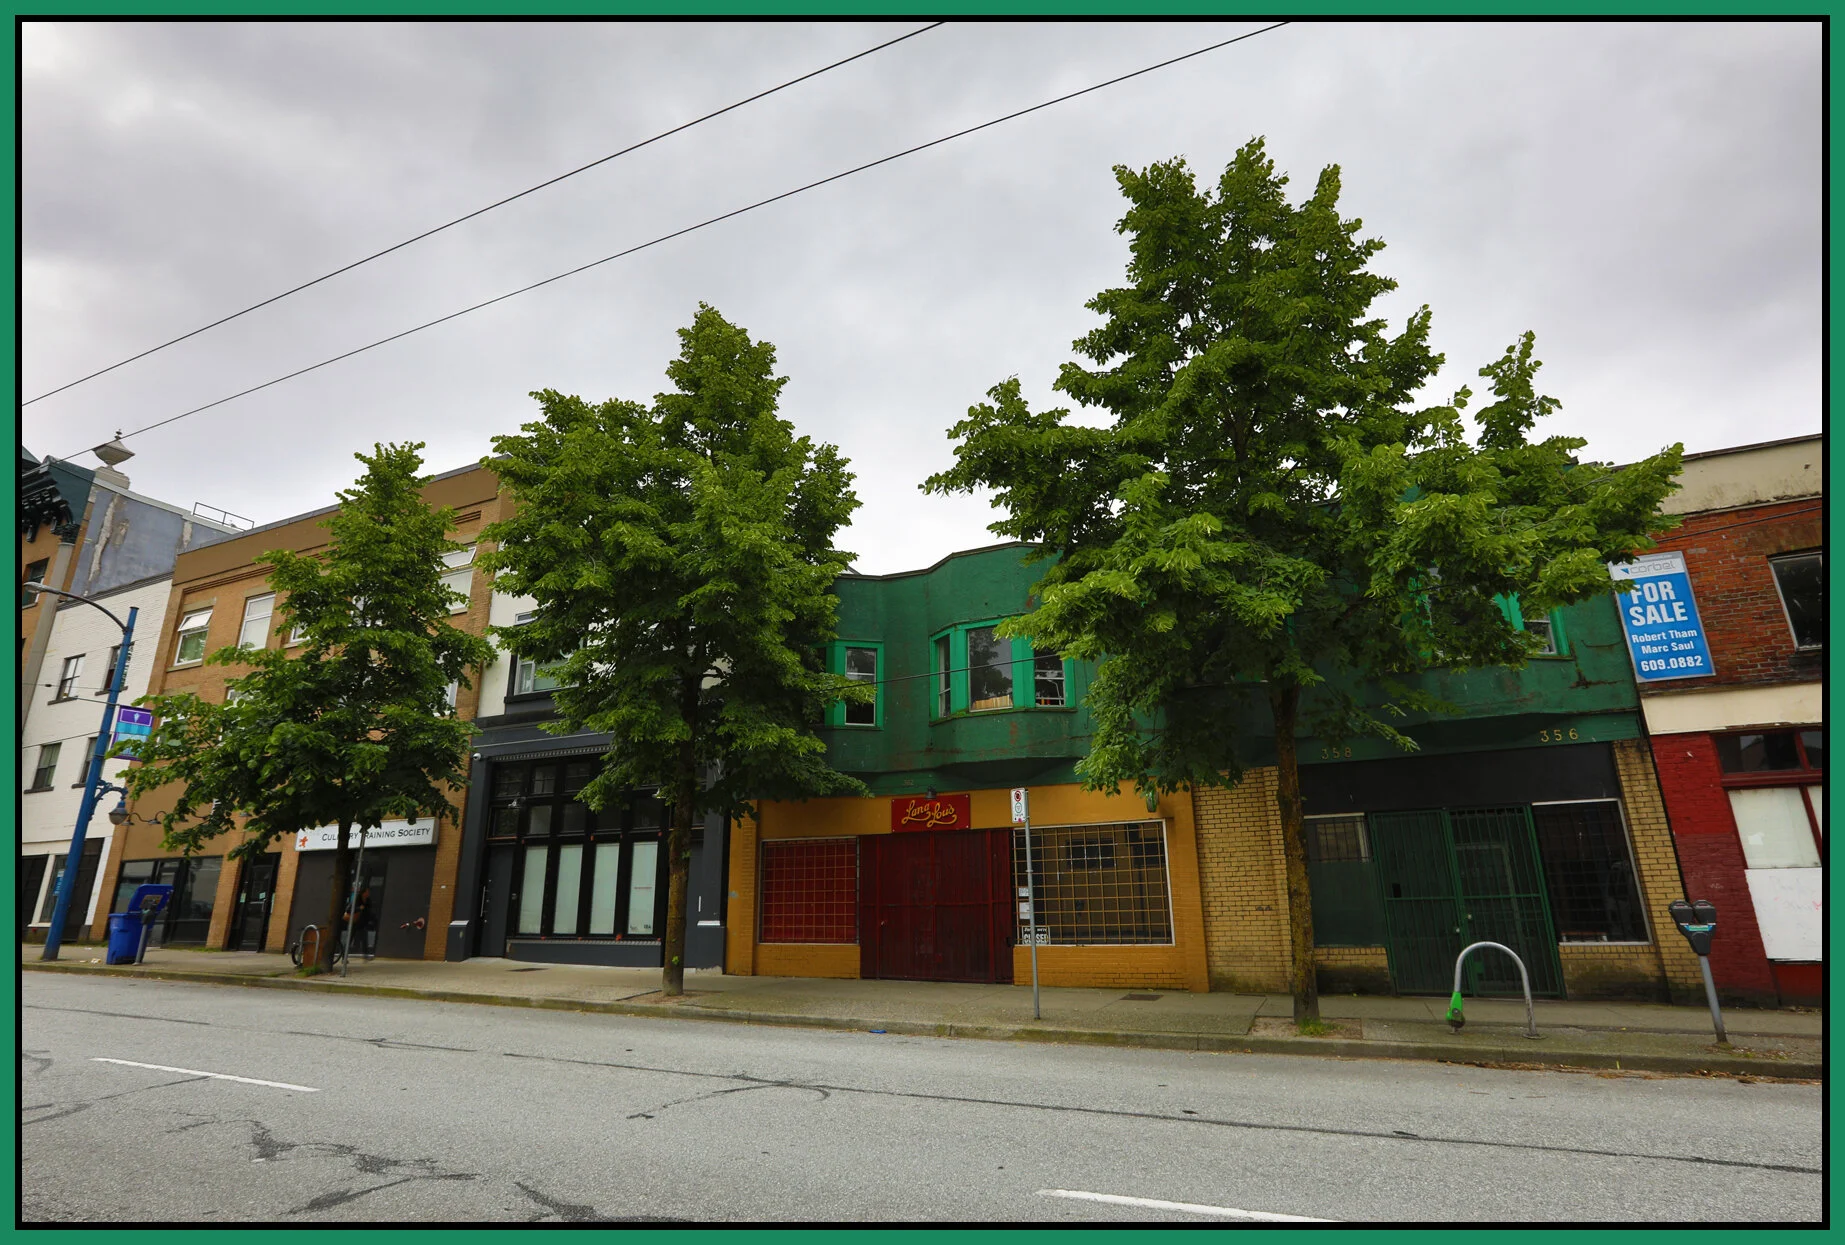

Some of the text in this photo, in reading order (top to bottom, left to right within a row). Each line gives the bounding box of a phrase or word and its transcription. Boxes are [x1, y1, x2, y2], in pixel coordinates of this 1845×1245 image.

[1630, 561, 1676, 572] corbel
[1630, 581, 1676, 604] FOR
[1629, 601, 1689, 627] SALE
[1632, 630, 1697, 643] Robert Tham
[1641, 641, 1695, 654] Marc Saul
[1641, 655, 1703, 672] 609.0882
[1539, 728, 1579, 743] 356
[1321, 746, 1352, 760] 358
[901, 800, 931, 824] Lana
[321, 827, 431, 842] CULRY RAINING SOCIETY
[1023, 933, 1049, 944] CLSED
